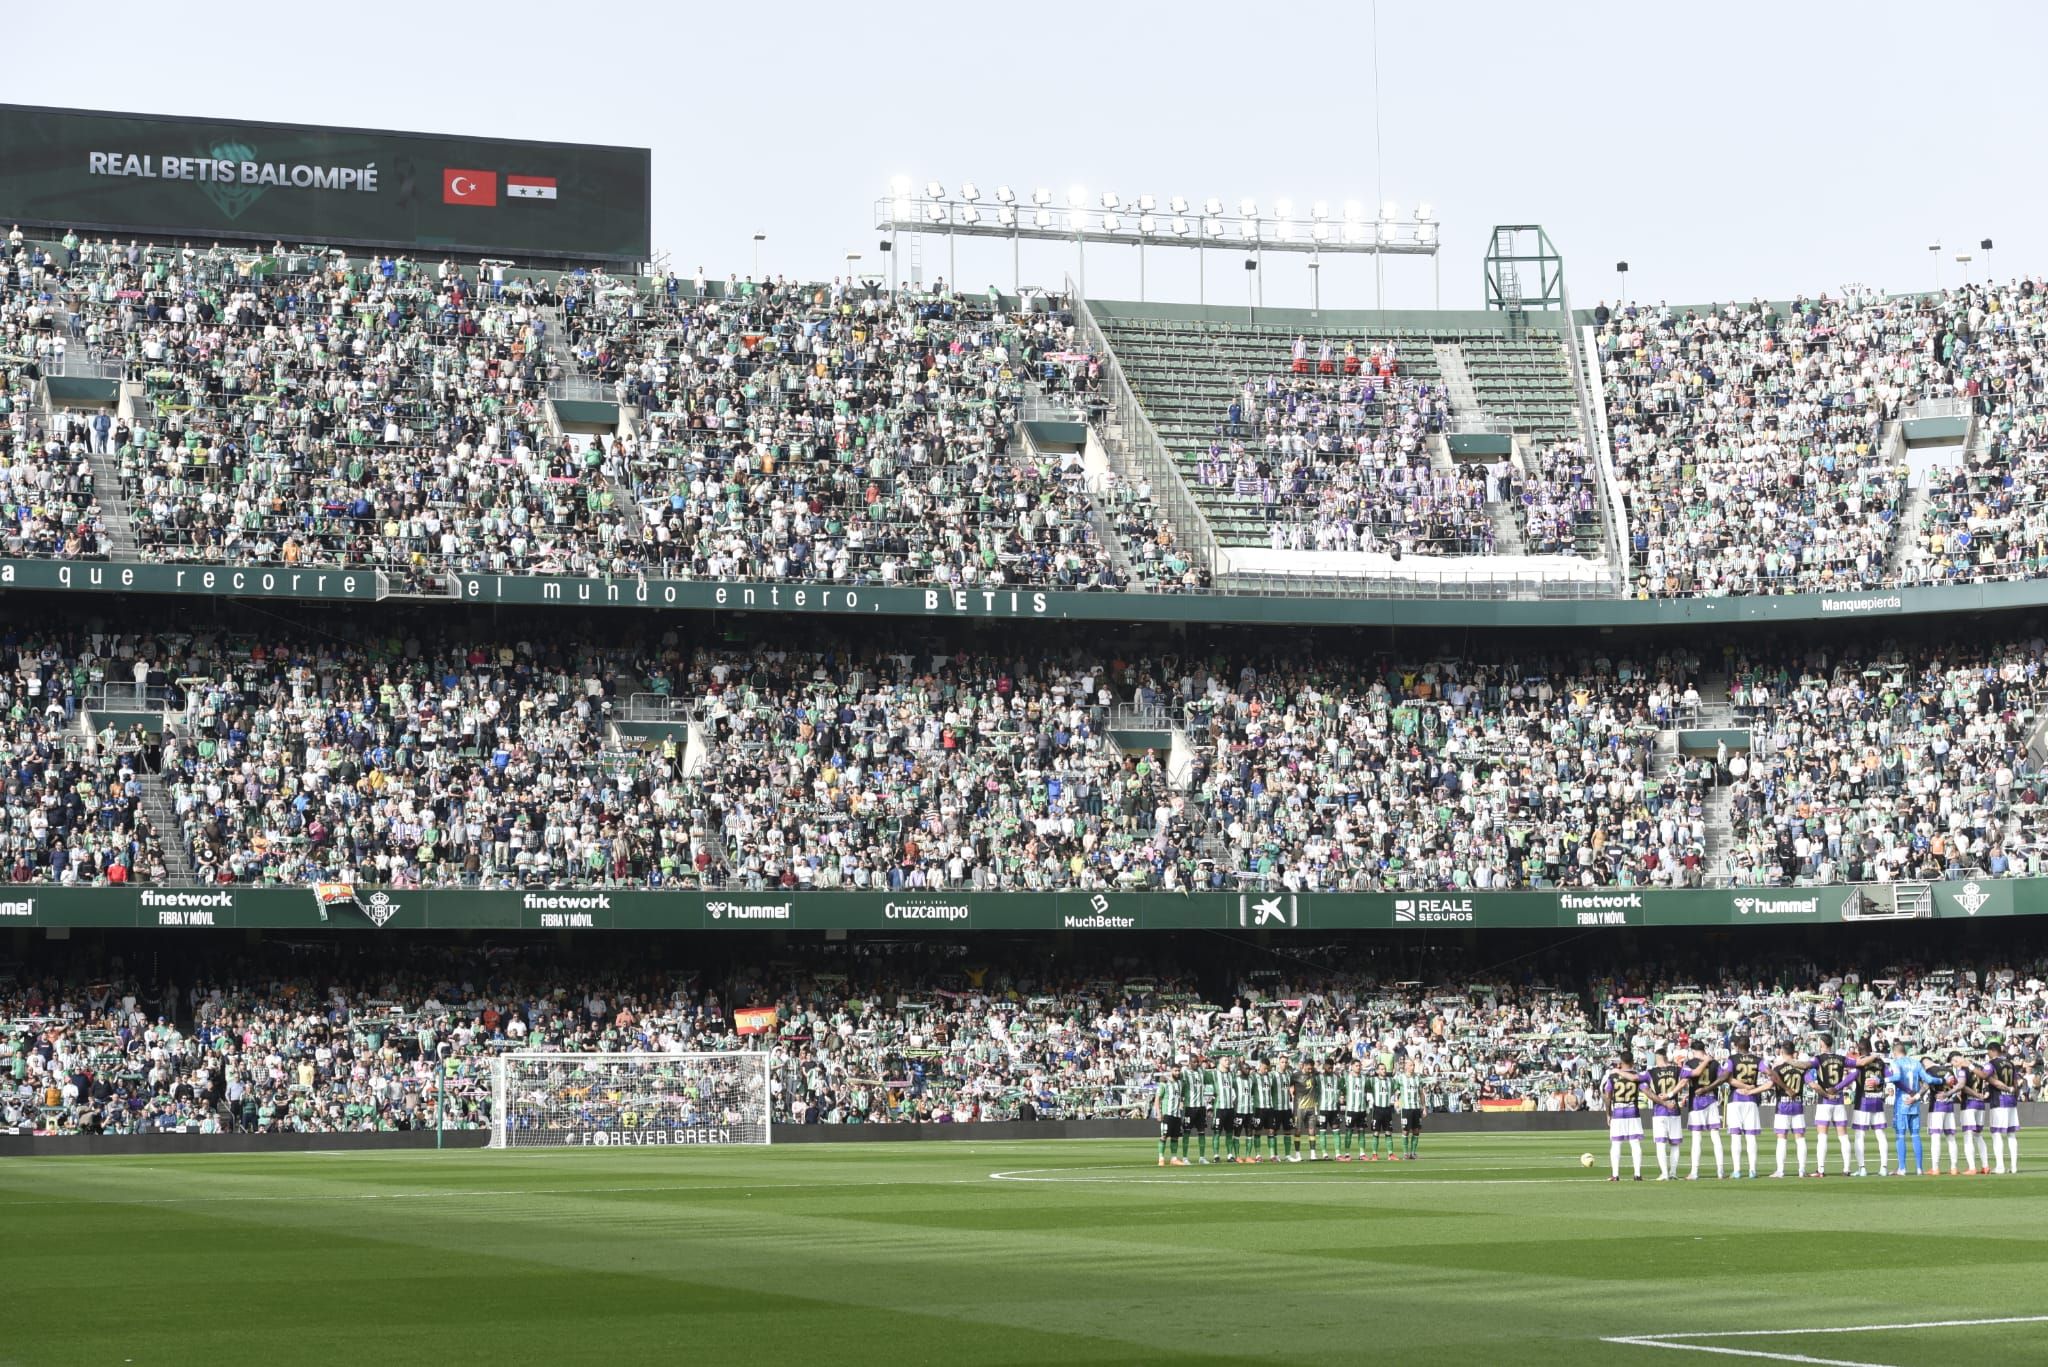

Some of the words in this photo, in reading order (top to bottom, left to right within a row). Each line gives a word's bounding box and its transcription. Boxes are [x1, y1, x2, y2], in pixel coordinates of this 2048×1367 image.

[89, 151, 157, 178] REAL
[161, 155, 236, 183] BETIS
[240, 161, 378, 192] BALOMPIÉ
[59, 566, 135, 588] que
[176, 569, 356, 593] recorre
[468, 577, 502, 597] el
[543, 579, 676, 602] mundo
[925, 590, 1048, 613] BETIS
[1822, 596, 1902, 613] Manquepierda
[0, 898, 33, 916] mel
[140, 890, 233, 907] finetwork
[523, 893, 611, 909] finetwork
[1418, 899, 1473, 912] REALE
[1559, 892, 1642, 909] finetwork
[1754, 896, 1817, 914] hummel
[158, 911, 181, 926] FIBRA
[182, 911, 191, 926] Y
[190, 909, 215, 926] MÓVIL
[541, 913, 564, 927] FIBRA
[564, 913, 571, 927] Y
[570, 911, 594, 927] MÓVIL
[727, 902, 790, 919] hummel
[885, 901, 969, 922] Cruzcampo
[1418, 912, 1473, 922] SEGUROS
[1577, 912, 1599, 925] FIBRA
[1598, 911, 1605, 925] Y
[1604, 910, 1627, 925] MÓVIL
[1064, 915, 1135, 928] MuchBetter
[1736, 1064, 1757, 1083] 25
[1827, 1063, 1839, 1085] 5
[1613, 1081, 1636, 1103] 22
[1658, 1077, 1676, 1096] 12
[674, 1129, 731, 1145] GREEN
